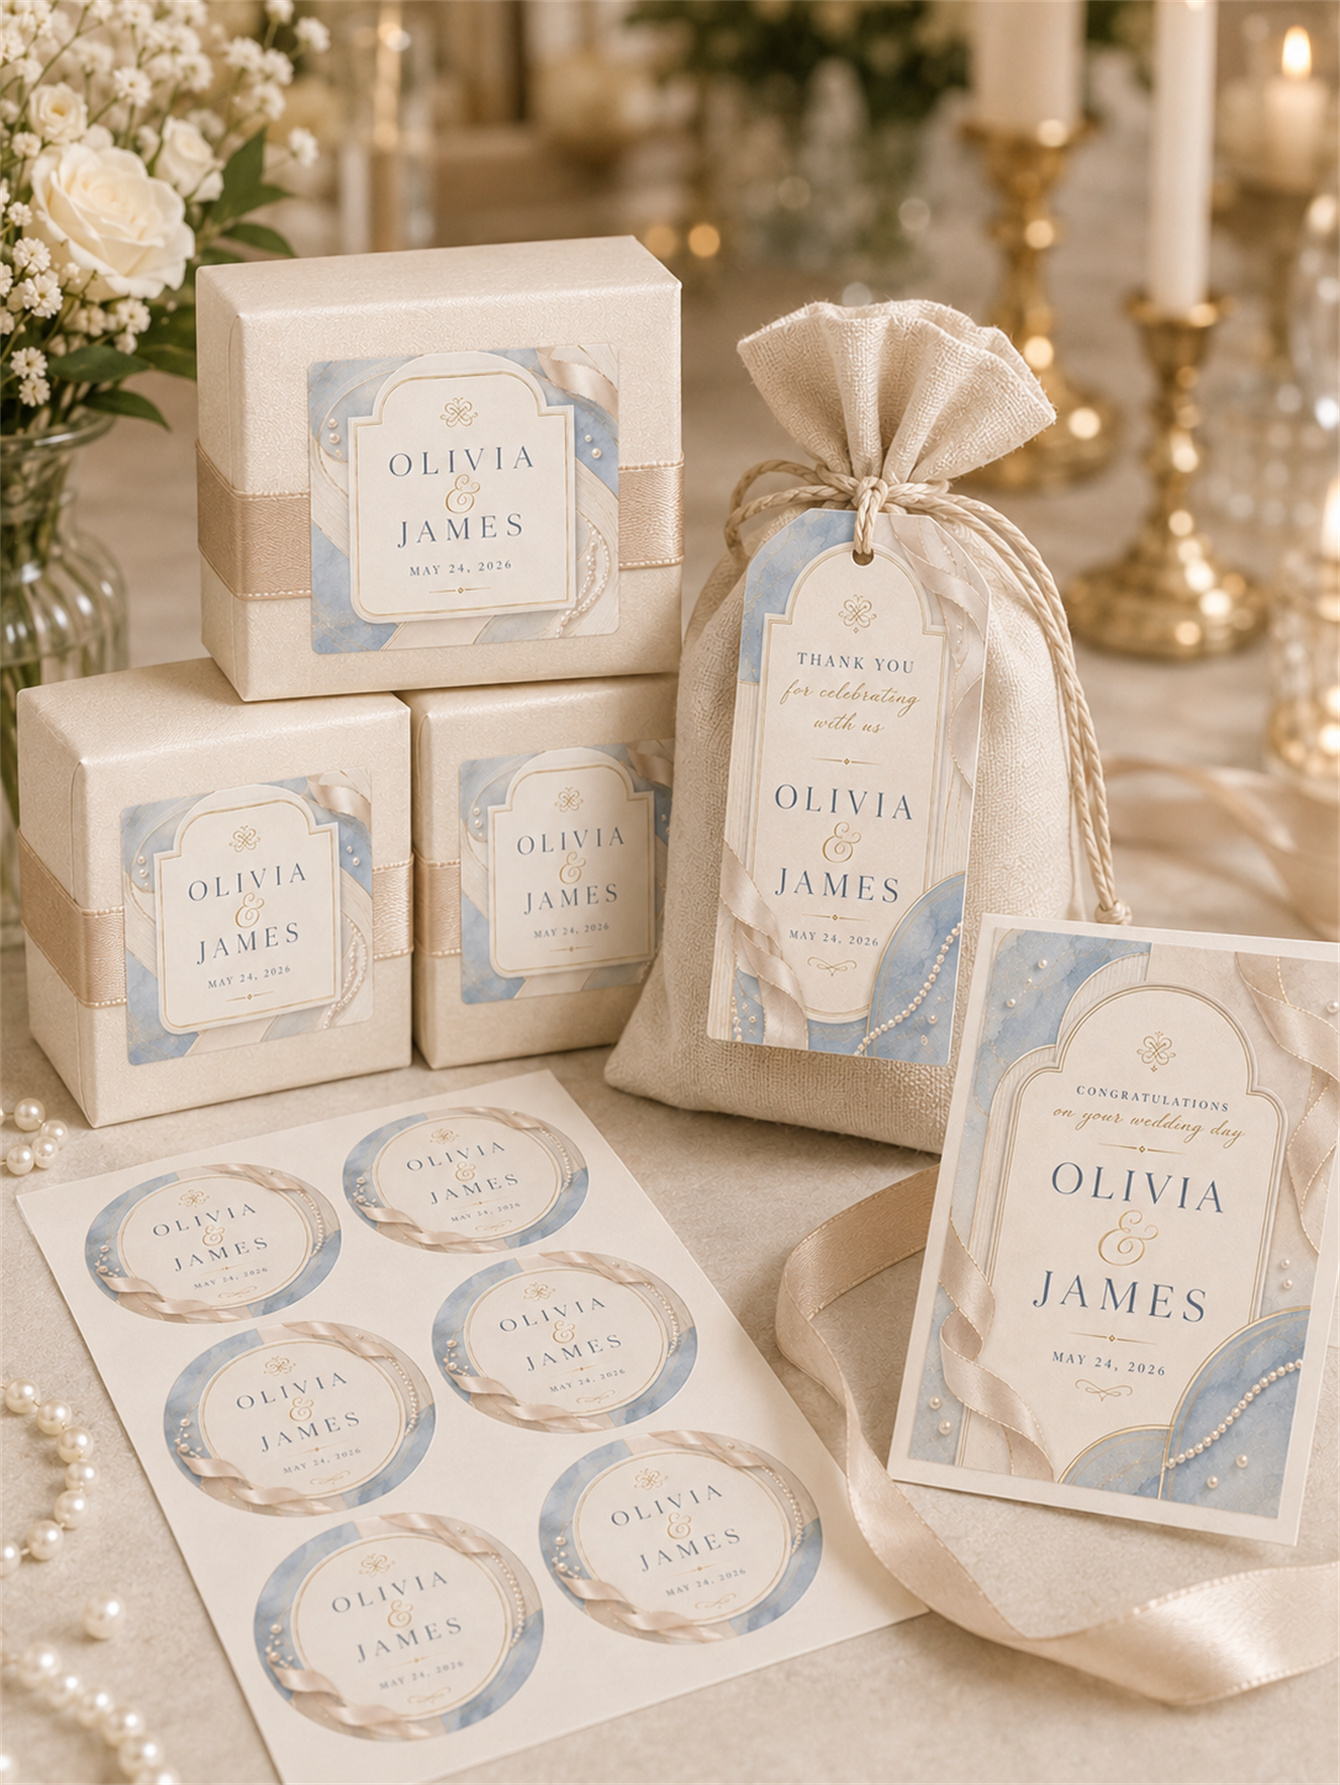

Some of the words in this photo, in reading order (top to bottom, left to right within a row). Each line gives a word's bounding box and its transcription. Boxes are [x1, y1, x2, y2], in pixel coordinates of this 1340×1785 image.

[388, 446, 534, 477] OLIVIA
[445, 474, 481, 513] &
[397, 513, 523, 548] JAMES
[410, 565, 441, 576] MAY
[449, 563, 470, 573] 24,
[478, 560, 512, 571] 2026
[797, 652, 864, 670] THANK
[875, 658, 914, 674] YOU
[780, 679, 813, 705] for
[819, 681, 921, 718] celebrating
[813, 713, 855, 731] with
[862, 722, 885, 734] us
[775, 784, 912, 820] OLIVIA
[517, 826, 624, 855] OLIVIA
[822, 821, 862, 863] &
[188, 862, 306, 901] OLIVIA
[559, 851, 586, 884] &
[524, 883, 617, 915] JAMES
[775, 868, 898, 903] JAMES
[235, 892, 264, 928] &
[197, 922, 299, 965] JAMES
[534, 928, 557, 939] MAY
[563, 927, 578, 935] 24,
[585, 923, 609, 933] 2026
[789, 930, 816, 940] MAY
[823, 933, 841, 944] 24,
[850, 935, 879, 946] 2026
[208, 976, 233, 989] MAY
[240, 973, 258, 983] 24,
[264, 965, 291, 979] 2026
[1076, 1085, 1229, 1112] CONGRATULATIONS
[1052, 1108, 1076, 1118] on
[1075, 1112, 1123, 1131] your
[1130, 1113, 1204, 1144] wedding
[1210, 1120, 1246, 1149] day
[406, 1142, 505, 1171] OLIVIA
[455, 1161, 476, 1182] &
[431, 1174, 518, 1205] JAMES
[1052, 1162, 1224, 1214] OLIVIA
[152, 1203, 256, 1237] OLIVIA
[451, 1214, 471, 1223] MAY
[202, 1225, 225, 1246] &
[1098, 1209, 1159, 1266] &
[174, 1237, 268, 1272] JAMES
[194, 1280, 216, 1290] MAY
[243, 1267, 268, 1278] 2026
[1032, 1270, 1206, 1322] JAMES
[499, 1298, 605, 1332] OLIVIA
[553, 1320, 575, 1343] &
[527, 1334, 622, 1372] JAMES
[1052, 1351, 1086, 1365] MAY
[1095, 1357, 1118, 1372] 24,
[1128, 1361, 1165, 1376] 2026
[236, 1372, 347, 1410] OLIVIA
[549, 1382, 572, 1393] MAY
[600, 1369, 625, 1380] 2026
[289, 1397, 314, 1422] &
[261, 1411, 359, 1452] JAMES
[283, 1462, 307, 1475] MAY
[336, 1448, 361, 1460] 2026
[611, 1485, 722, 1526] OLIVIA
[667, 1512, 692, 1539] &
[640, 1528, 740, 1572] JAMES
[332, 1571, 447, 1613] OLIVIA
[666, 1584, 690, 1597] MAY
[719, 1568, 746, 1581] 2026
[388, 1600, 414, 1629] &
[357, 1617, 461, 1663] JAMES
[379, 1677, 405, 1690] MAY
[436, 1660, 464, 1673] 2026
